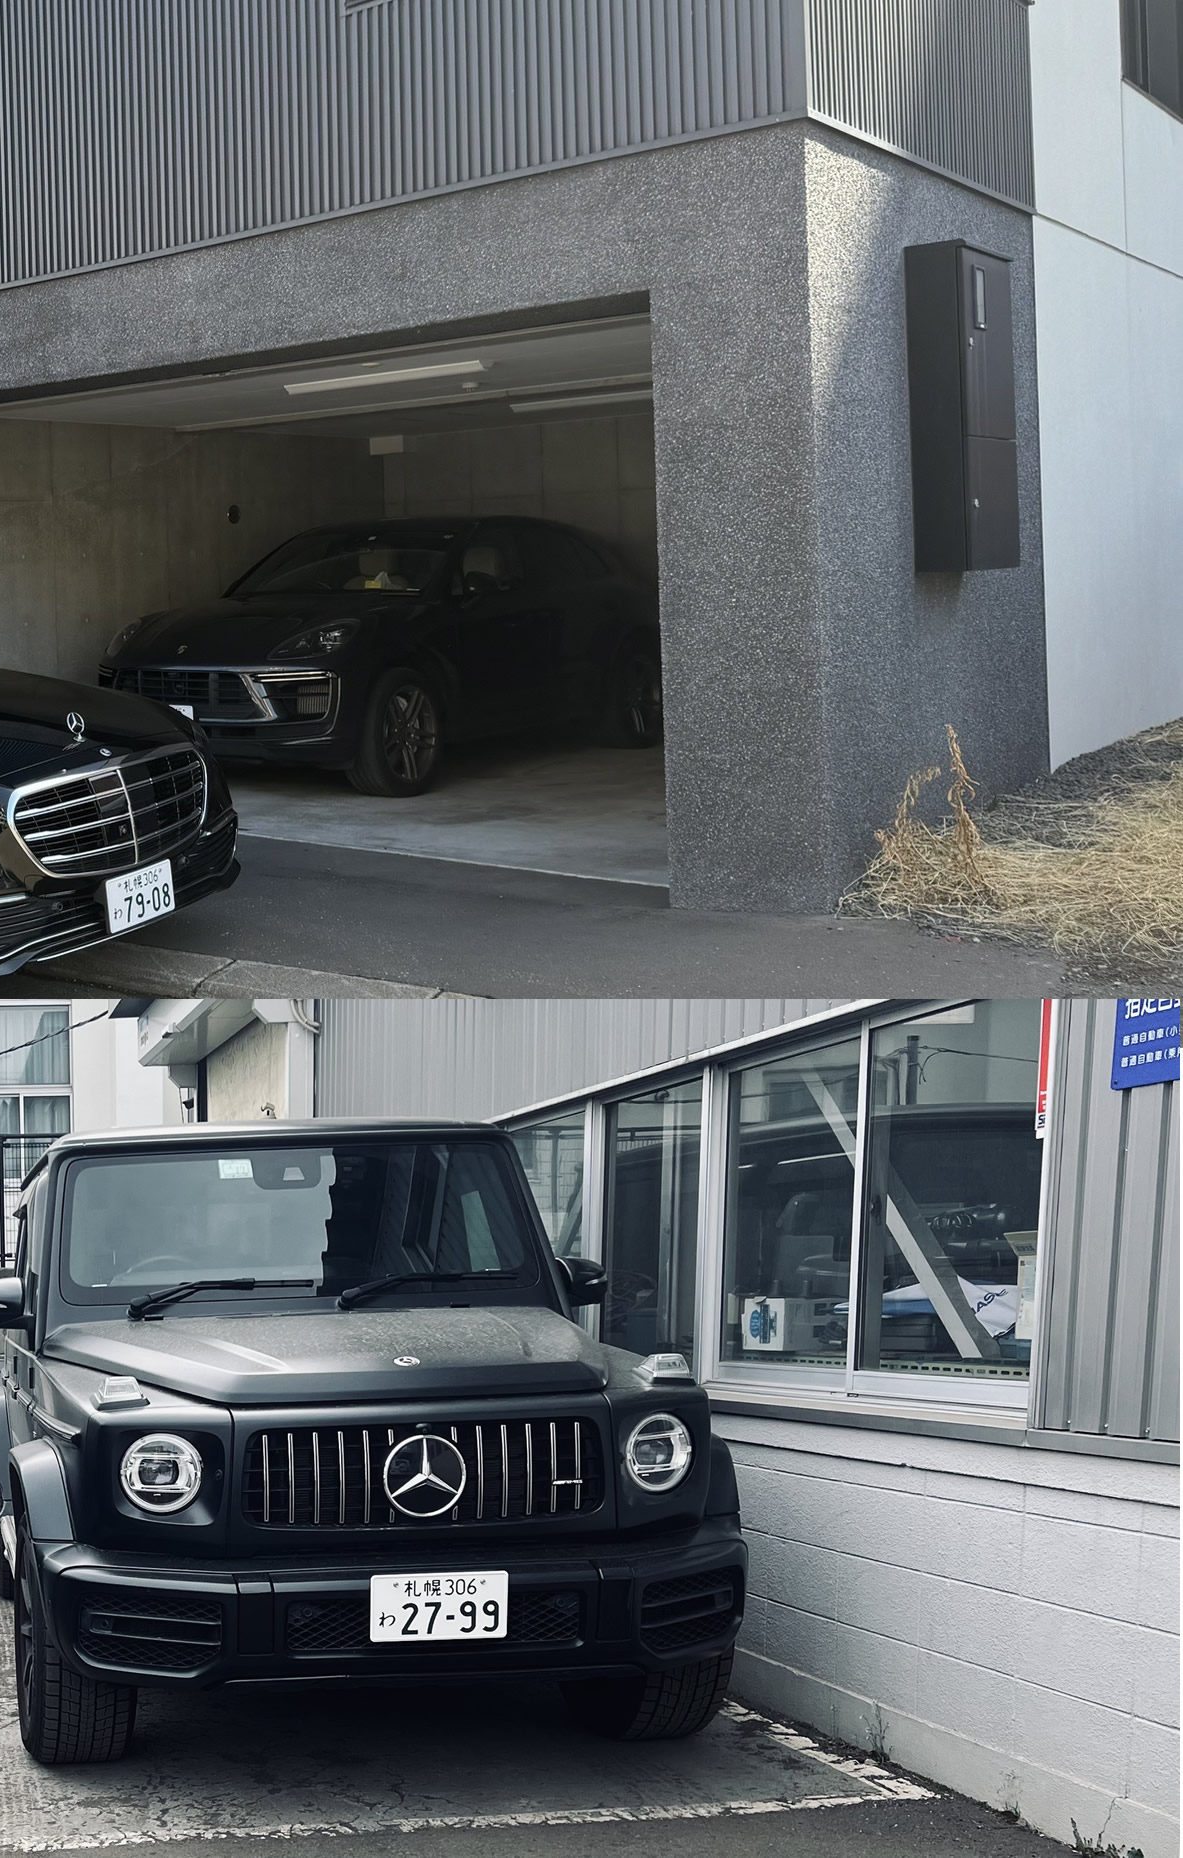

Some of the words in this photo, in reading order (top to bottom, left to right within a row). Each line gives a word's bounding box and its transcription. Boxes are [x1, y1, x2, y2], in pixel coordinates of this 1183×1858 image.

[123, 882, 171, 923] 79-08
[404, 1578, 477, 1597] 札幌306
[378, 1611, 396, 1628] わ
[401, 1600, 499, 1635] 27-99
